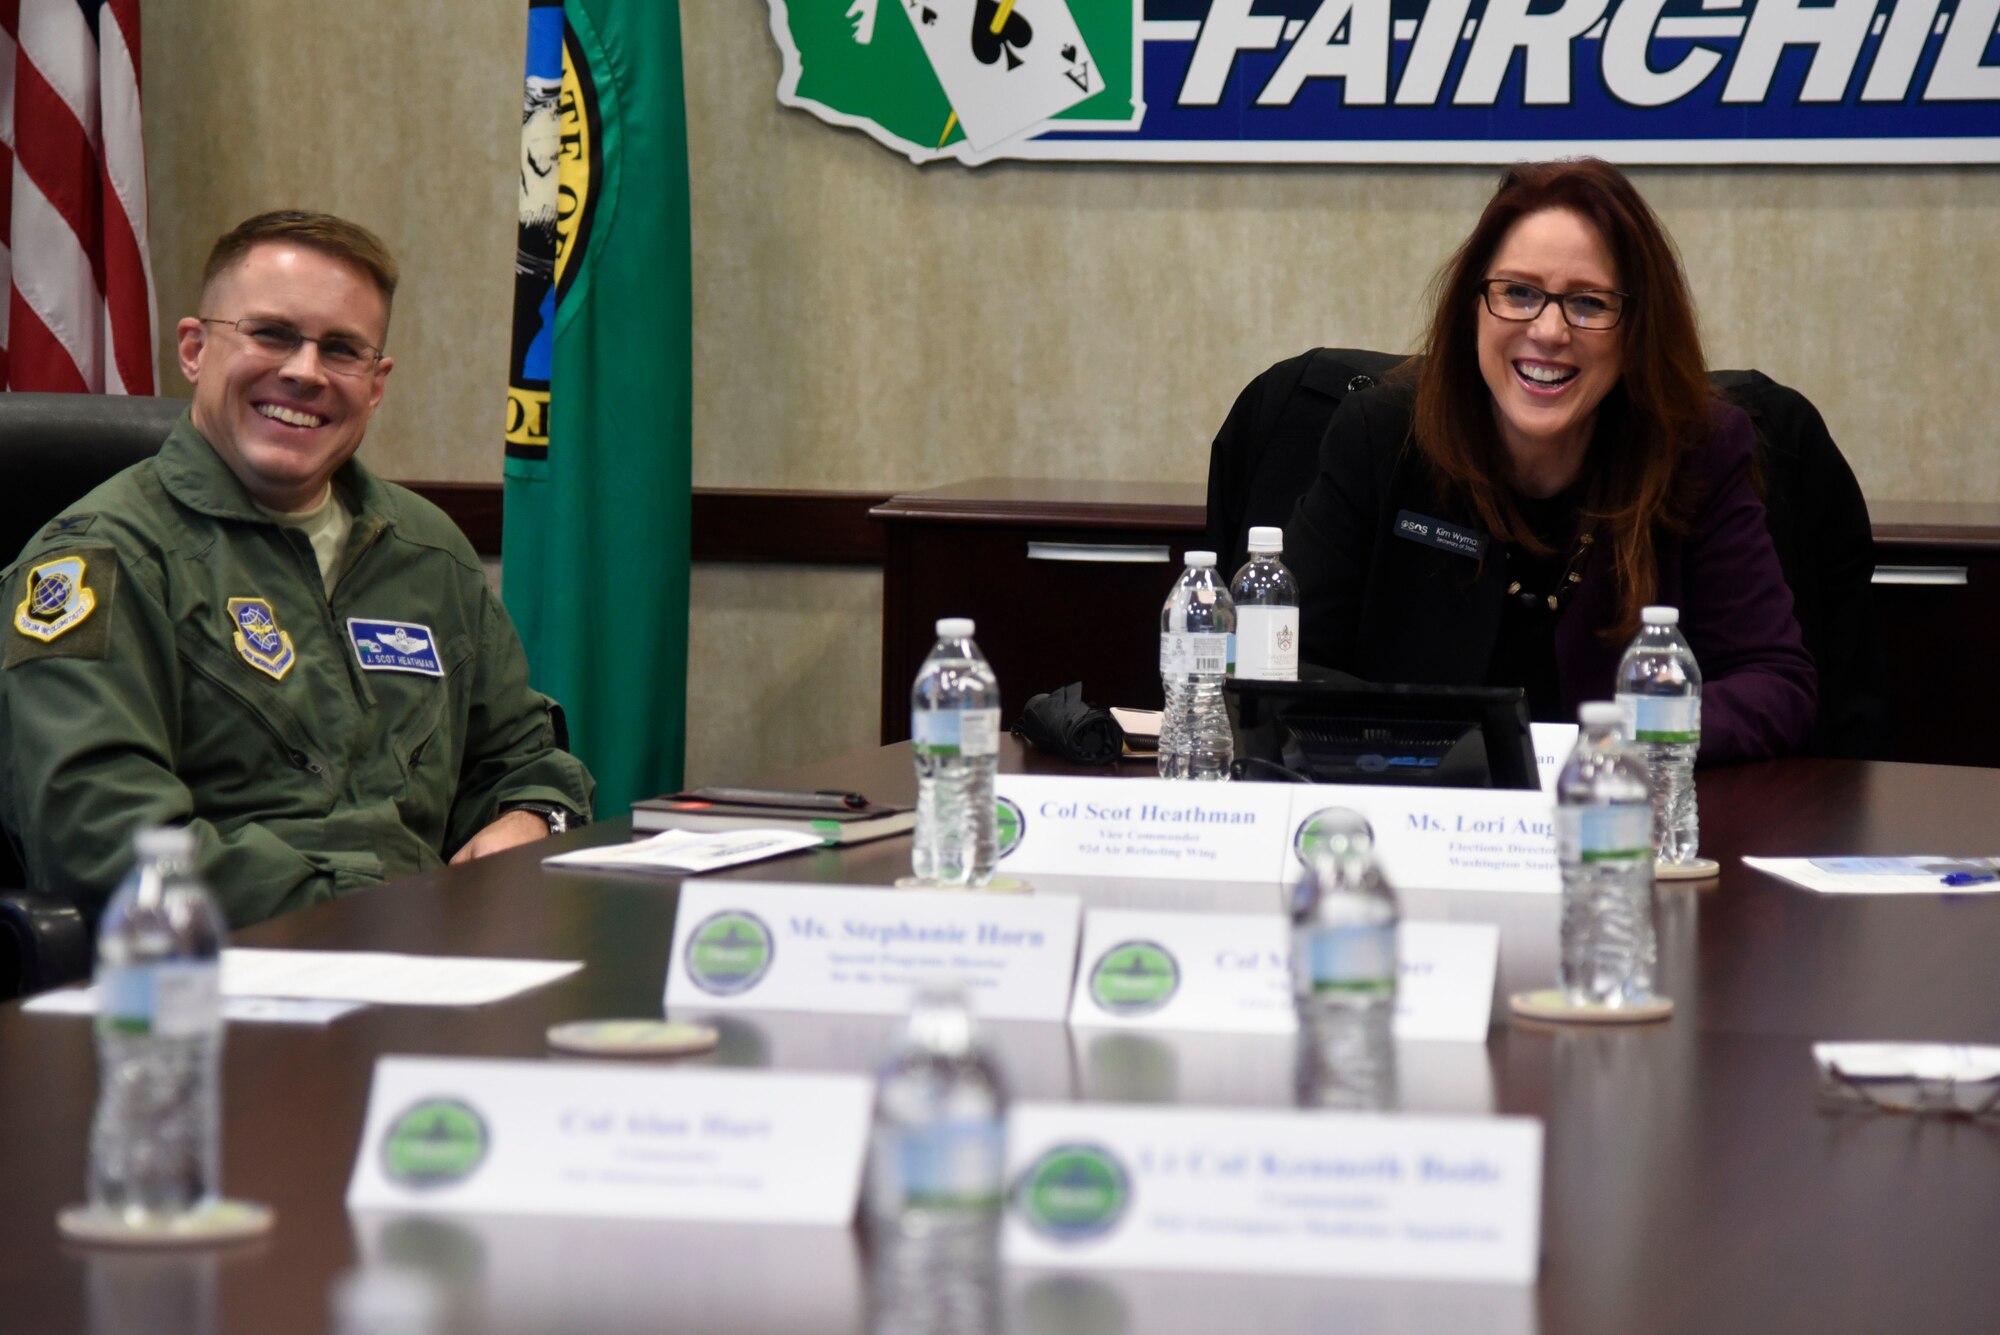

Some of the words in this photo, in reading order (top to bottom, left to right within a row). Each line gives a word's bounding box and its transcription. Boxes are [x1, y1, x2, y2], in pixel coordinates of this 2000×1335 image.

[1435, 526, 1452, 539] Kim
[1452, 532, 1479, 546] Wyma
[375, 655, 396, 664] SCOT
[397, 656, 435, 669] HEATHMAN
[1040, 801, 1078, 820] Col
[1084, 803, 1132, 822] Scot
[1141, 804, 1257, 825] Heathman
[1407, 813, 1447, 832] Ms.
[1456, 815, 1505, 834] Lori
[1511, 817, 1556, 839] Aug
[1099, 829, 1124, 840] Vice
[1127, 830, 1202, 843] Commander
[1105, 845, 1123, 856] Air
[1126, 845, 1182, 859] Refueling
[1187, 847, 1218, 860] Wing
[1449, 842, 1504, 855] Elections
[1449, 857, 1522, 872] Washington
[843, 919, 969, 947] Stephanie
[977, 924, 1046, 947] Horn
